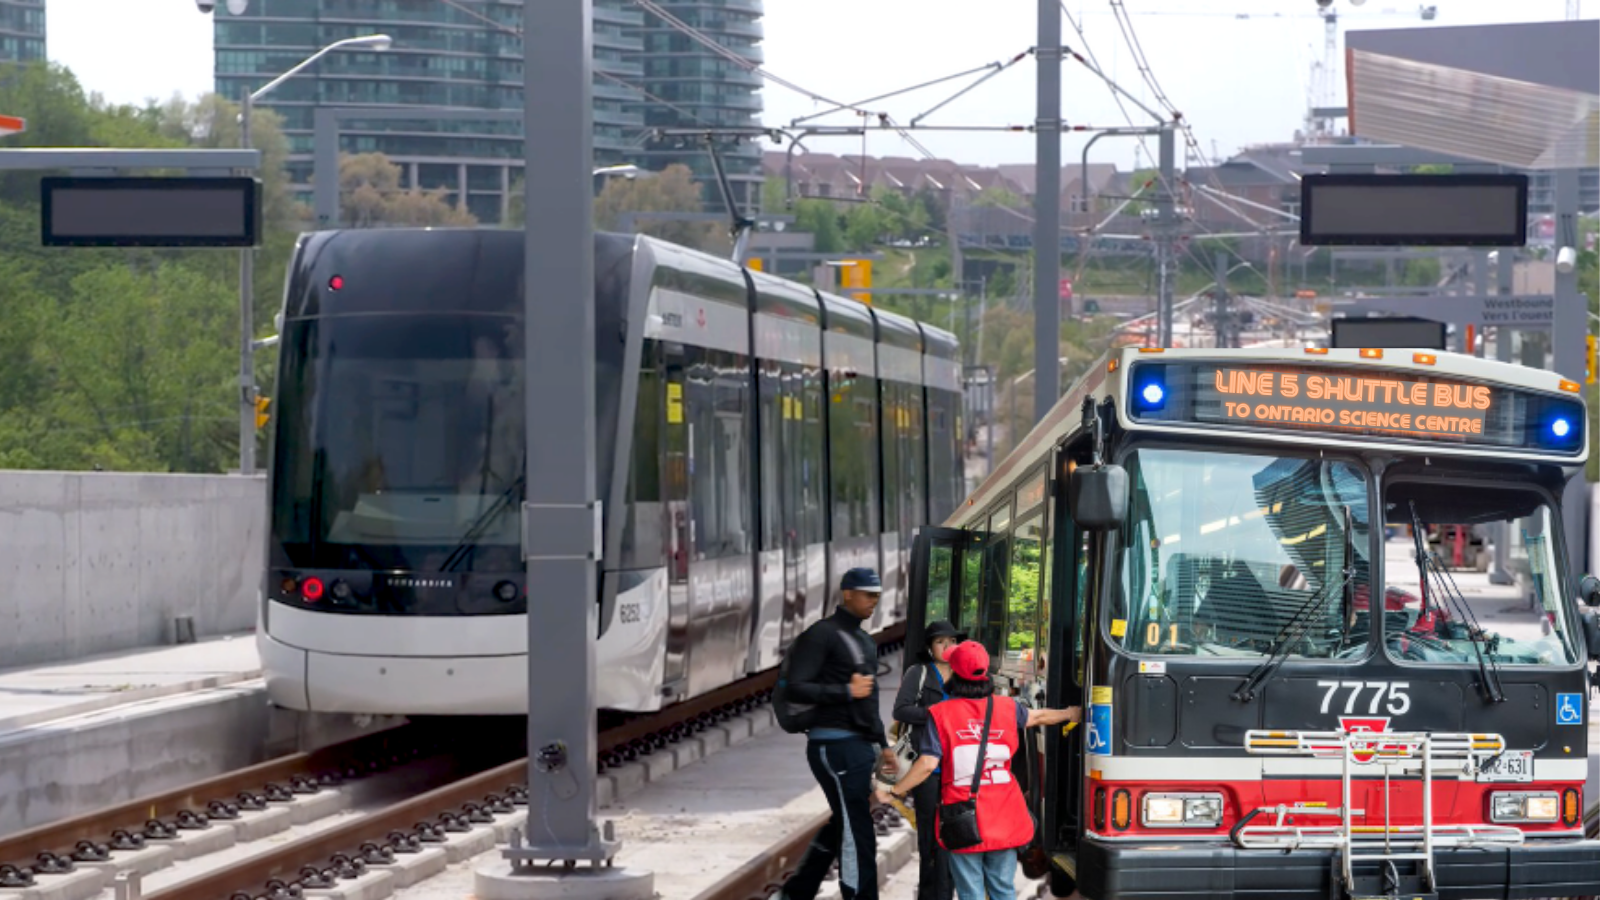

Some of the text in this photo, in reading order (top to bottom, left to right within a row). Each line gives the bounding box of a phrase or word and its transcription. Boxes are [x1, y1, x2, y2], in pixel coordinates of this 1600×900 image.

[1481, 311, 1509, 321] Vers
[1484, 298, 1553, 309] Westbound
[1215, 370, 1491, 410] LINE 5 SHUTTLE BUS
[1225, 401, 1482, 434] TO ONTARIO SCIENCE CENTRE
[620, 603, 641, 624] 6252
[1317, 680, 1411, 716] 7775
